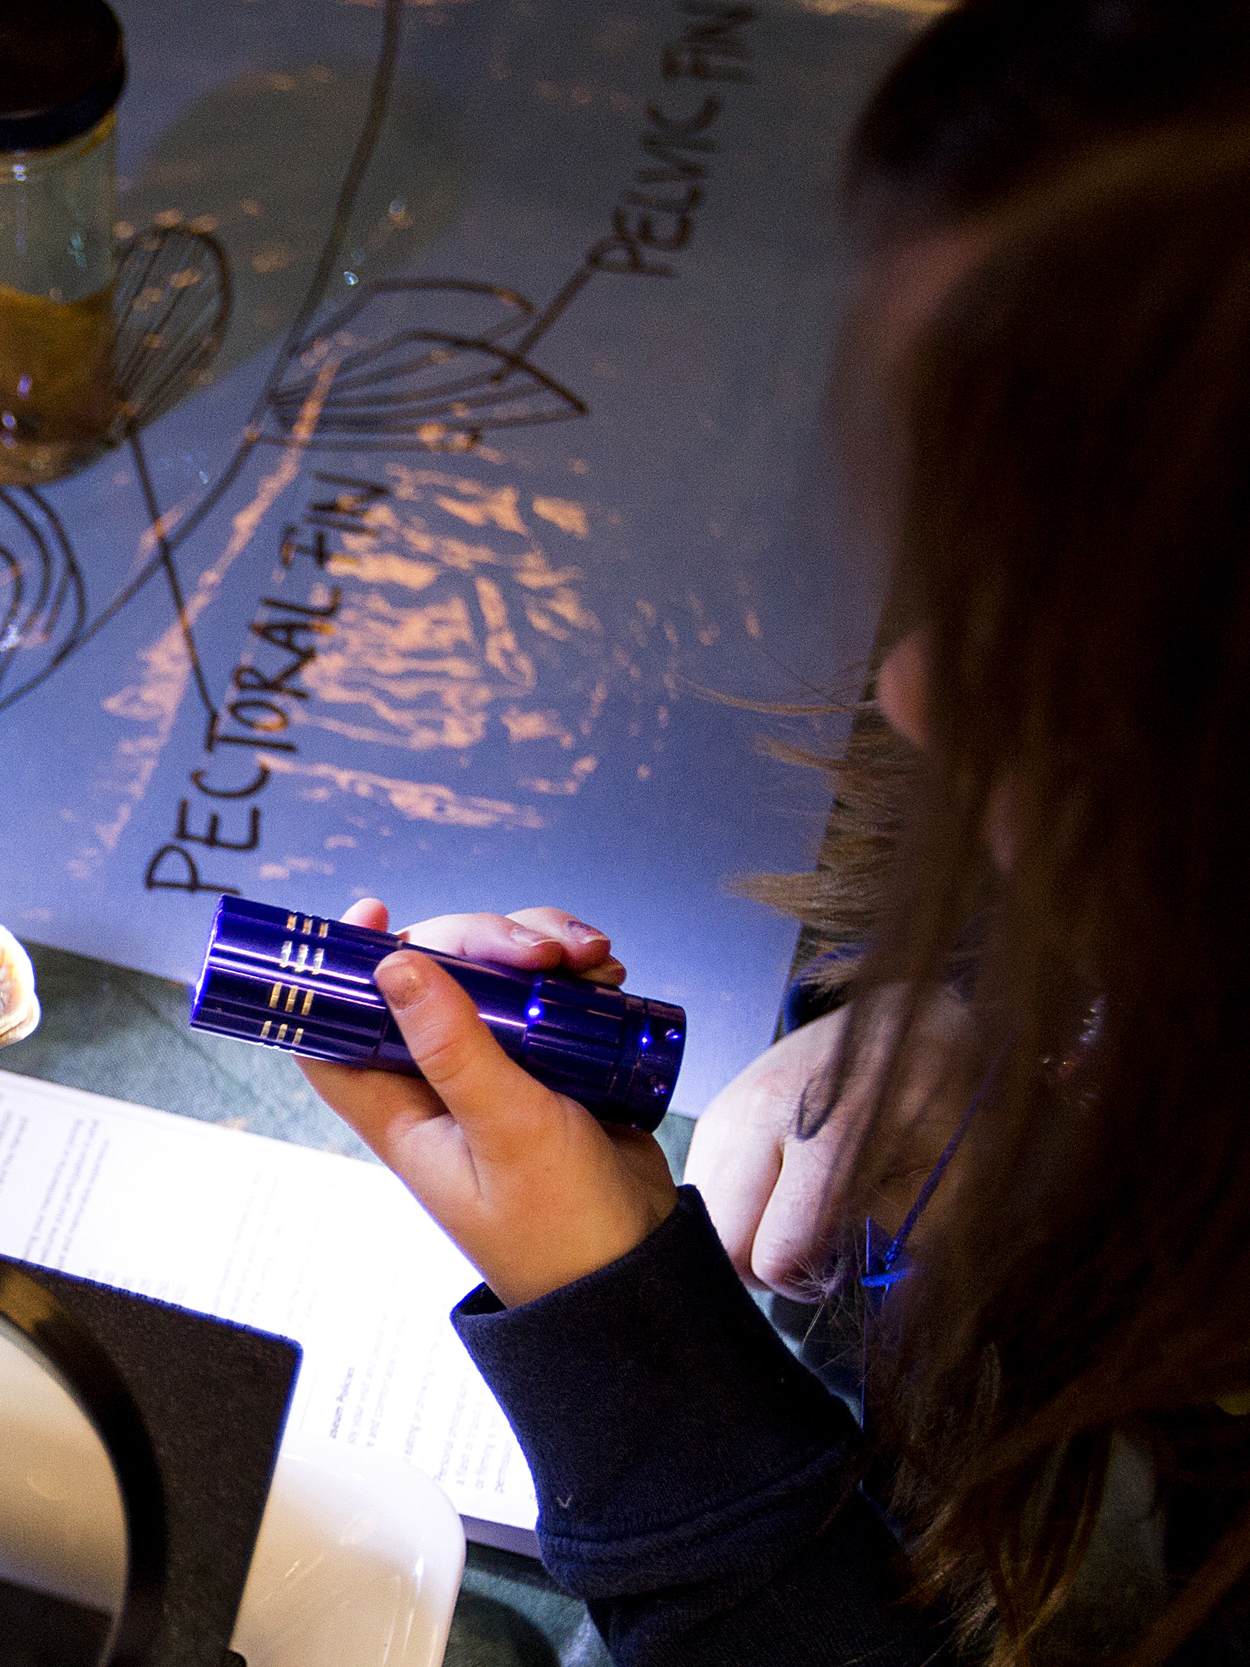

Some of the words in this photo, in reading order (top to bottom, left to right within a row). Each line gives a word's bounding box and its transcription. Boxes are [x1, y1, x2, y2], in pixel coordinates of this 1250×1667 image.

[585, 92, 721, 279] PELVIC
[662, 0, 757, 84] FIN
[146, 586, 342, 896] PECTORAL
[280, 471, 391, 568] FIN
